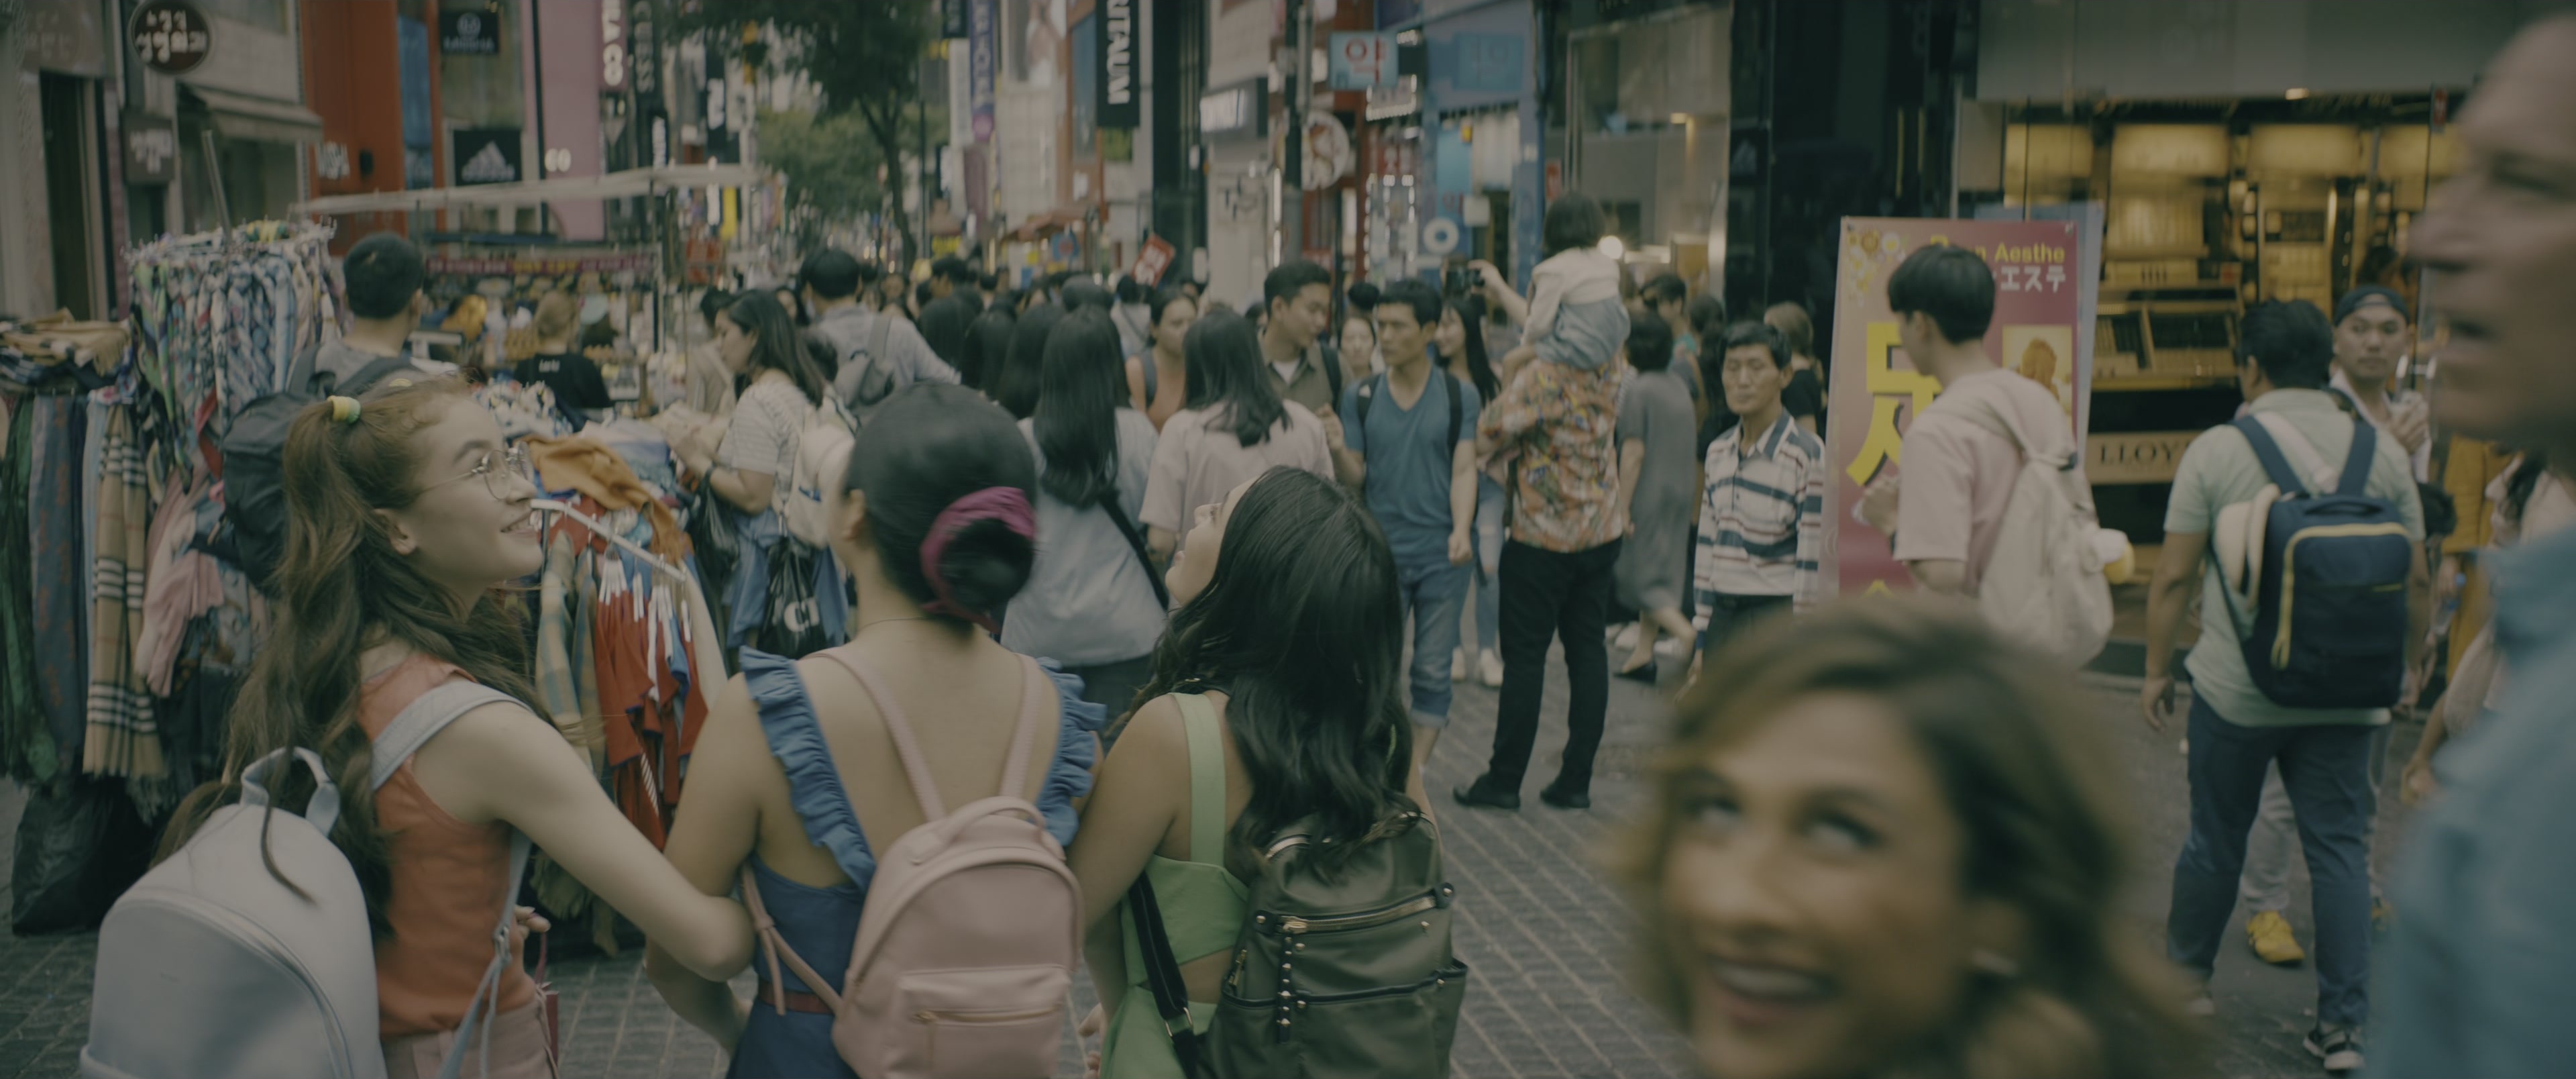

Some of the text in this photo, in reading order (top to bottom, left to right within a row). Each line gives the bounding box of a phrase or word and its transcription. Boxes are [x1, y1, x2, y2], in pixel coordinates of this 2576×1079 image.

[1345, 36, 1388, 84] 약
[1994, 242, 2065, 264] Aesthe
[1992, 265, 2066, 293] エステ
[2098, 442, 2191, 465] LLOY
